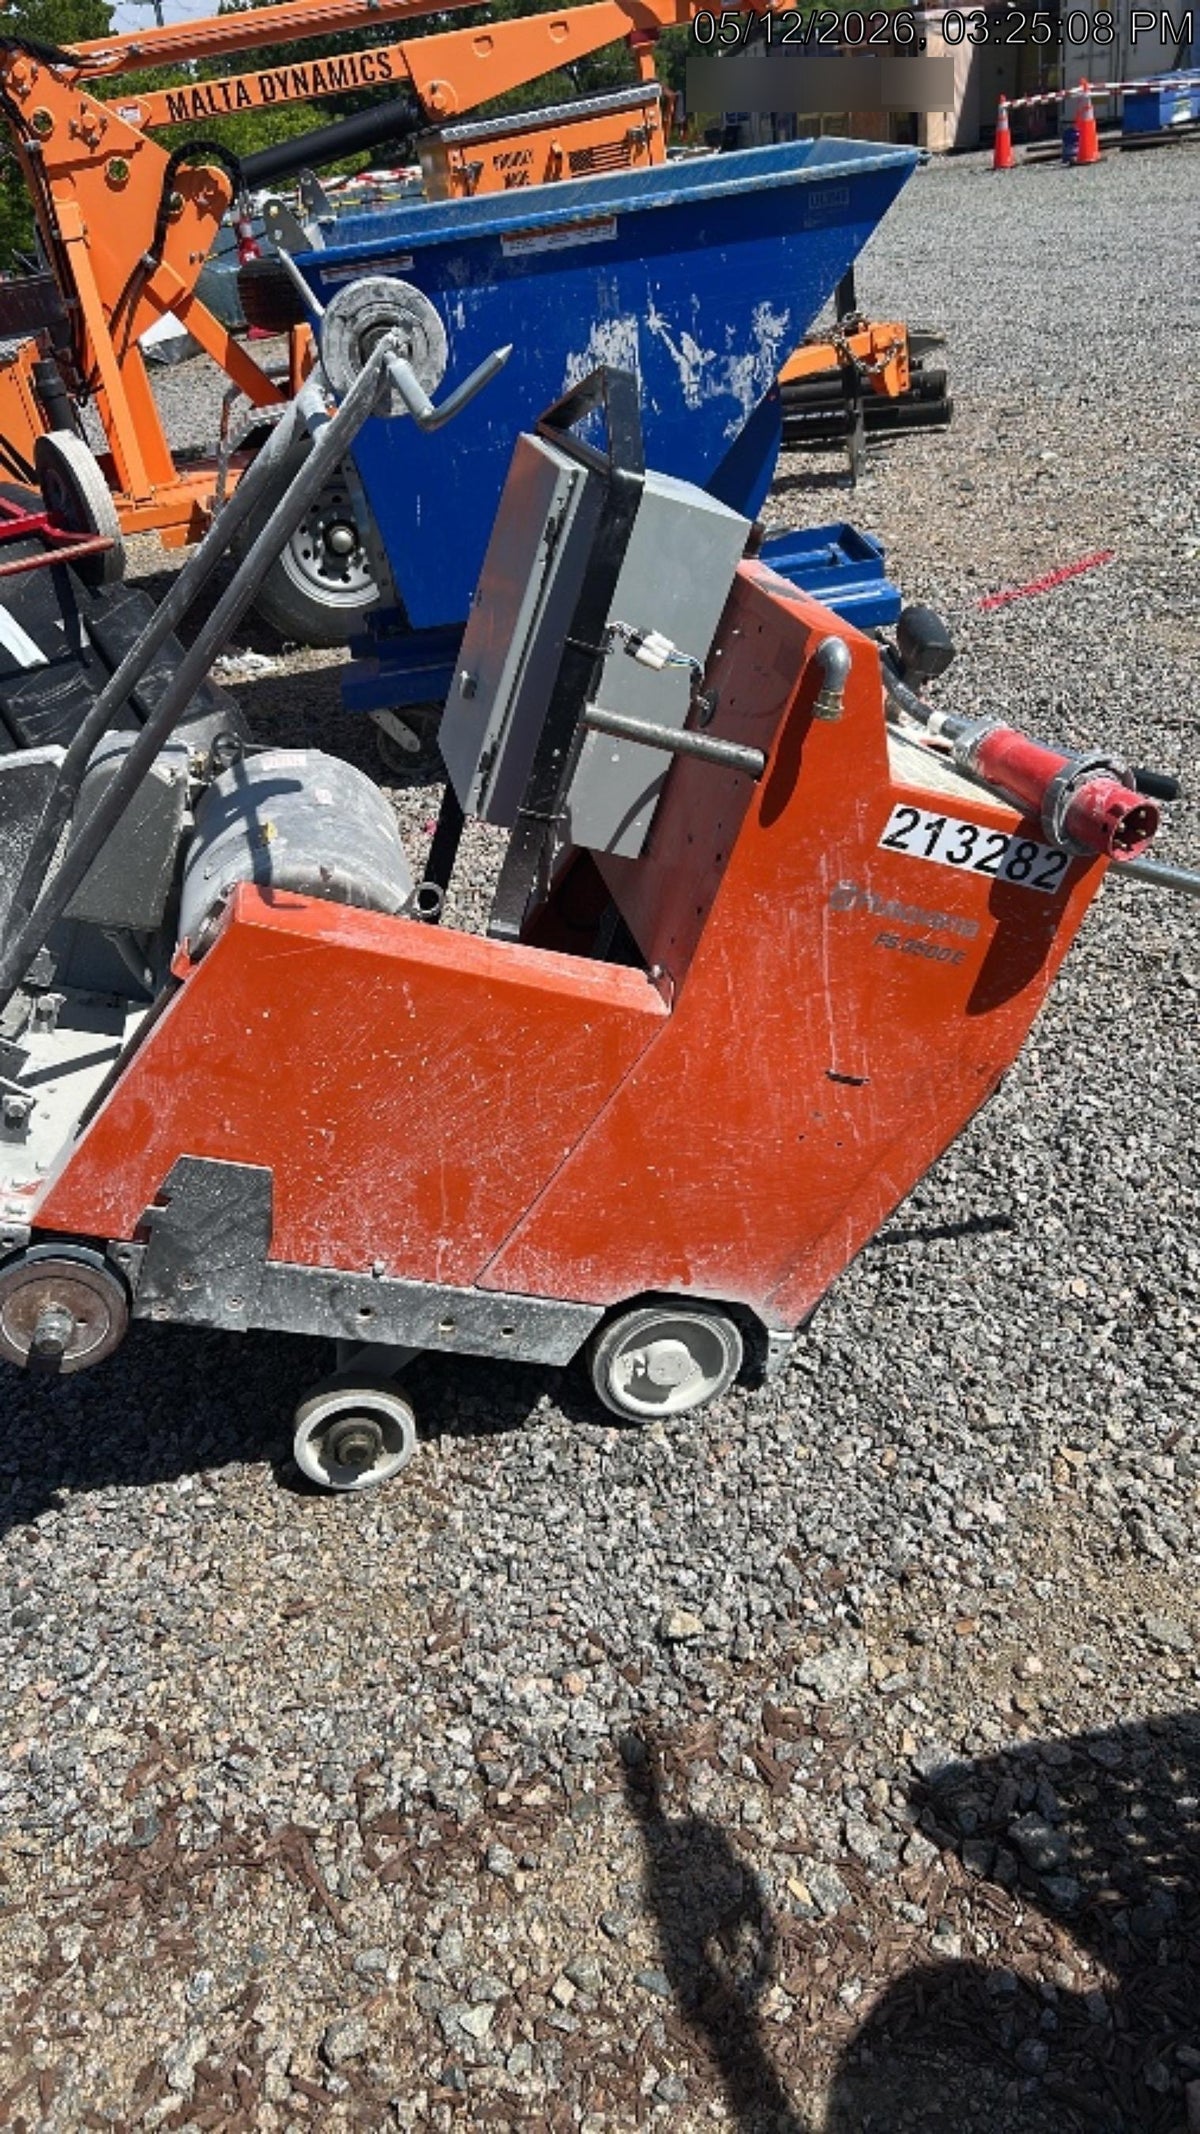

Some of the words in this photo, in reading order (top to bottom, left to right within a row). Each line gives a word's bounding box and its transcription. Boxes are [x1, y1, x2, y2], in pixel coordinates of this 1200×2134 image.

[165, 79, 252, 122] MALTA
[258, 52, 393, 101] DYNAMICS
[882, 808, 1068, 890] 213282
